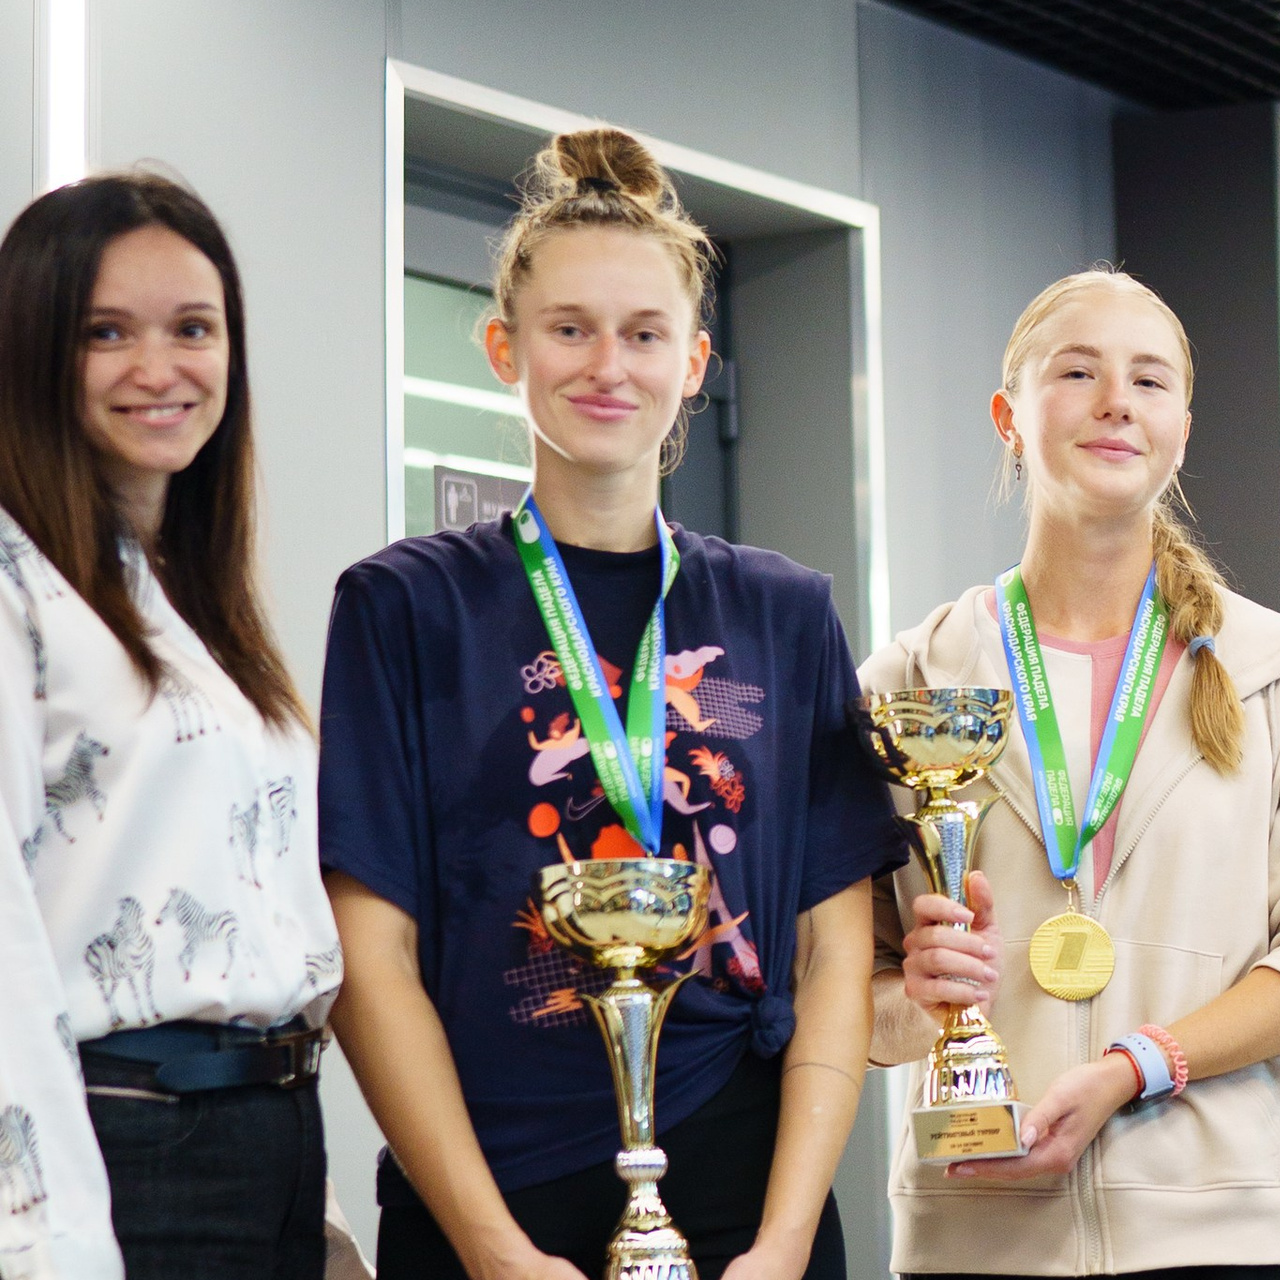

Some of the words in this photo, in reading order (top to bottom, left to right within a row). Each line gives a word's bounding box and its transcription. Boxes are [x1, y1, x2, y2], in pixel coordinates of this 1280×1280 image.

[1002, 600, 1030, 692] КРАСНОДАРСКОГО
[1022, 692, 1038, 722] КРАЯ
[1015, 602, 1038, 665] ФЕДЕРАЦИЯ
[1030, 664, 1050, 710] ПАДЕЛА
[1122, 597, 1155, 694] КРАСНОДАРСКОГО
[1142, 614, 1166, 677] ФЕДЕРАЦИЯ
[1113, 693, 1131, 723] КРАЯ
[1130, 674, 1151, 718] ПАДЕЛА
[1052, 930, 1089, 971] 1
